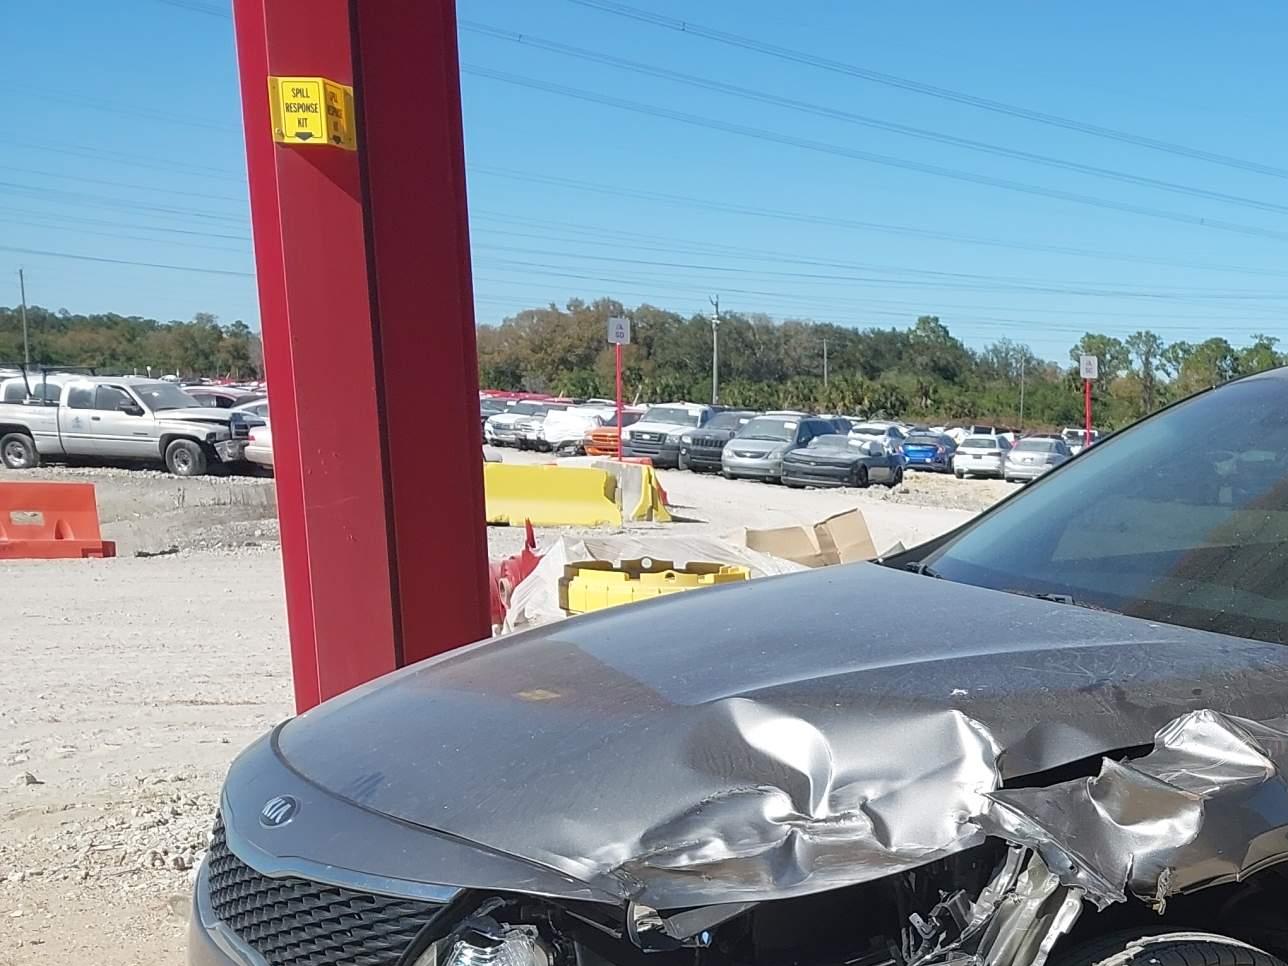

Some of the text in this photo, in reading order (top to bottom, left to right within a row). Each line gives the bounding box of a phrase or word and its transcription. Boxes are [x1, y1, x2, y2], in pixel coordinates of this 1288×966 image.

[291, 87, 310, 98] SPILL
[285, 102, 319, 113] RESPONSE
[297, 118, 308, 128] KIT
